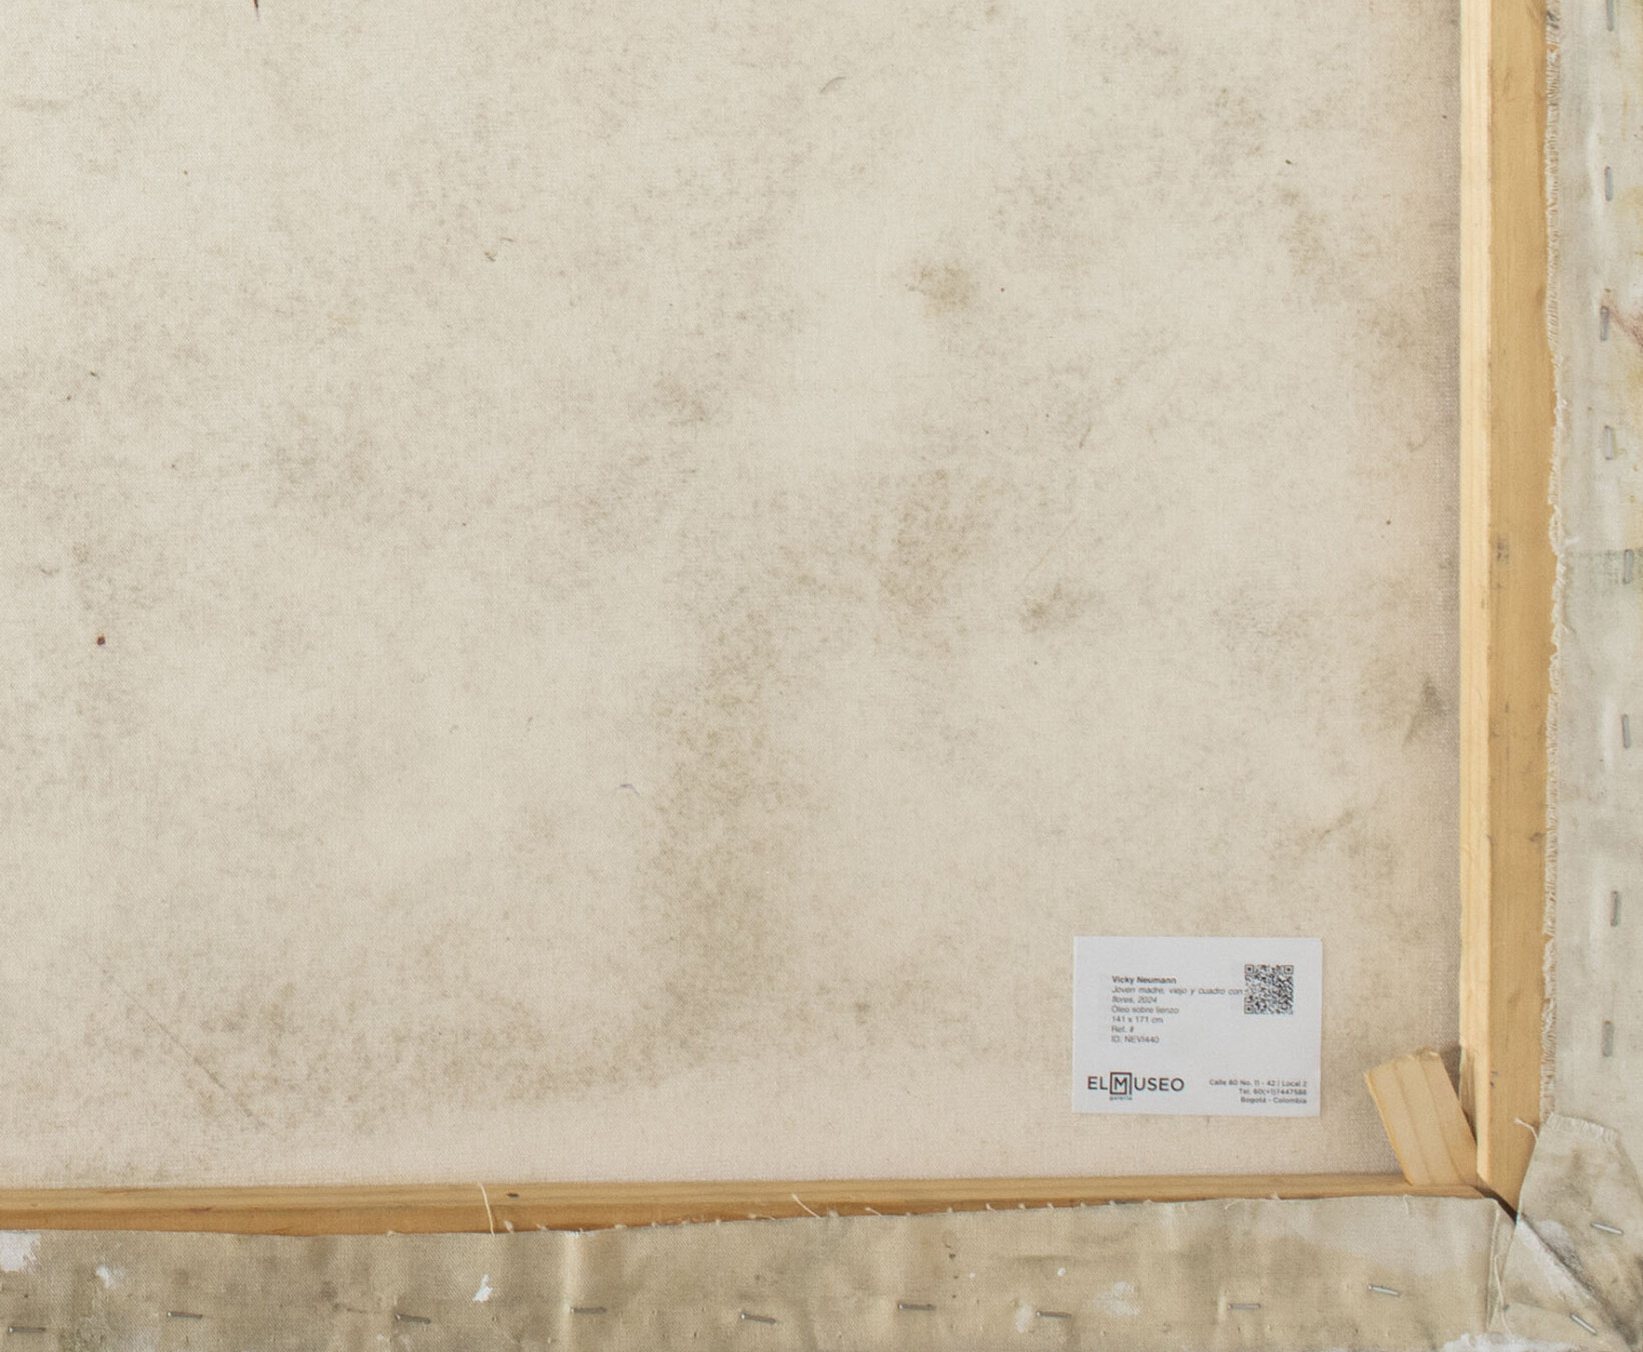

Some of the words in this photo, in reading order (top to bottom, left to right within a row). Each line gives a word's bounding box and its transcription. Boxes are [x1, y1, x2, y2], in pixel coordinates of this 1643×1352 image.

[1112, 975, 1134, 985] Vicky
[1136, 975, 1177, 984] Neumann
[1169, 987, 1187, 996] viejo
[1198, 986, 1226, 995] cuadro
[1137, 996, 1157, 1004] 2024
[1132, 1006, 1154, 1014] sobre
[1156, 1006, 1179, 1014] lienzo
[1112, 1015, 1125, 1023] 141
[1135, 1015, 1149, 1023] 171
[1087, 1076, 1108, 1090] EL
[1112, 1074, 1185, 1092] MUSEO
